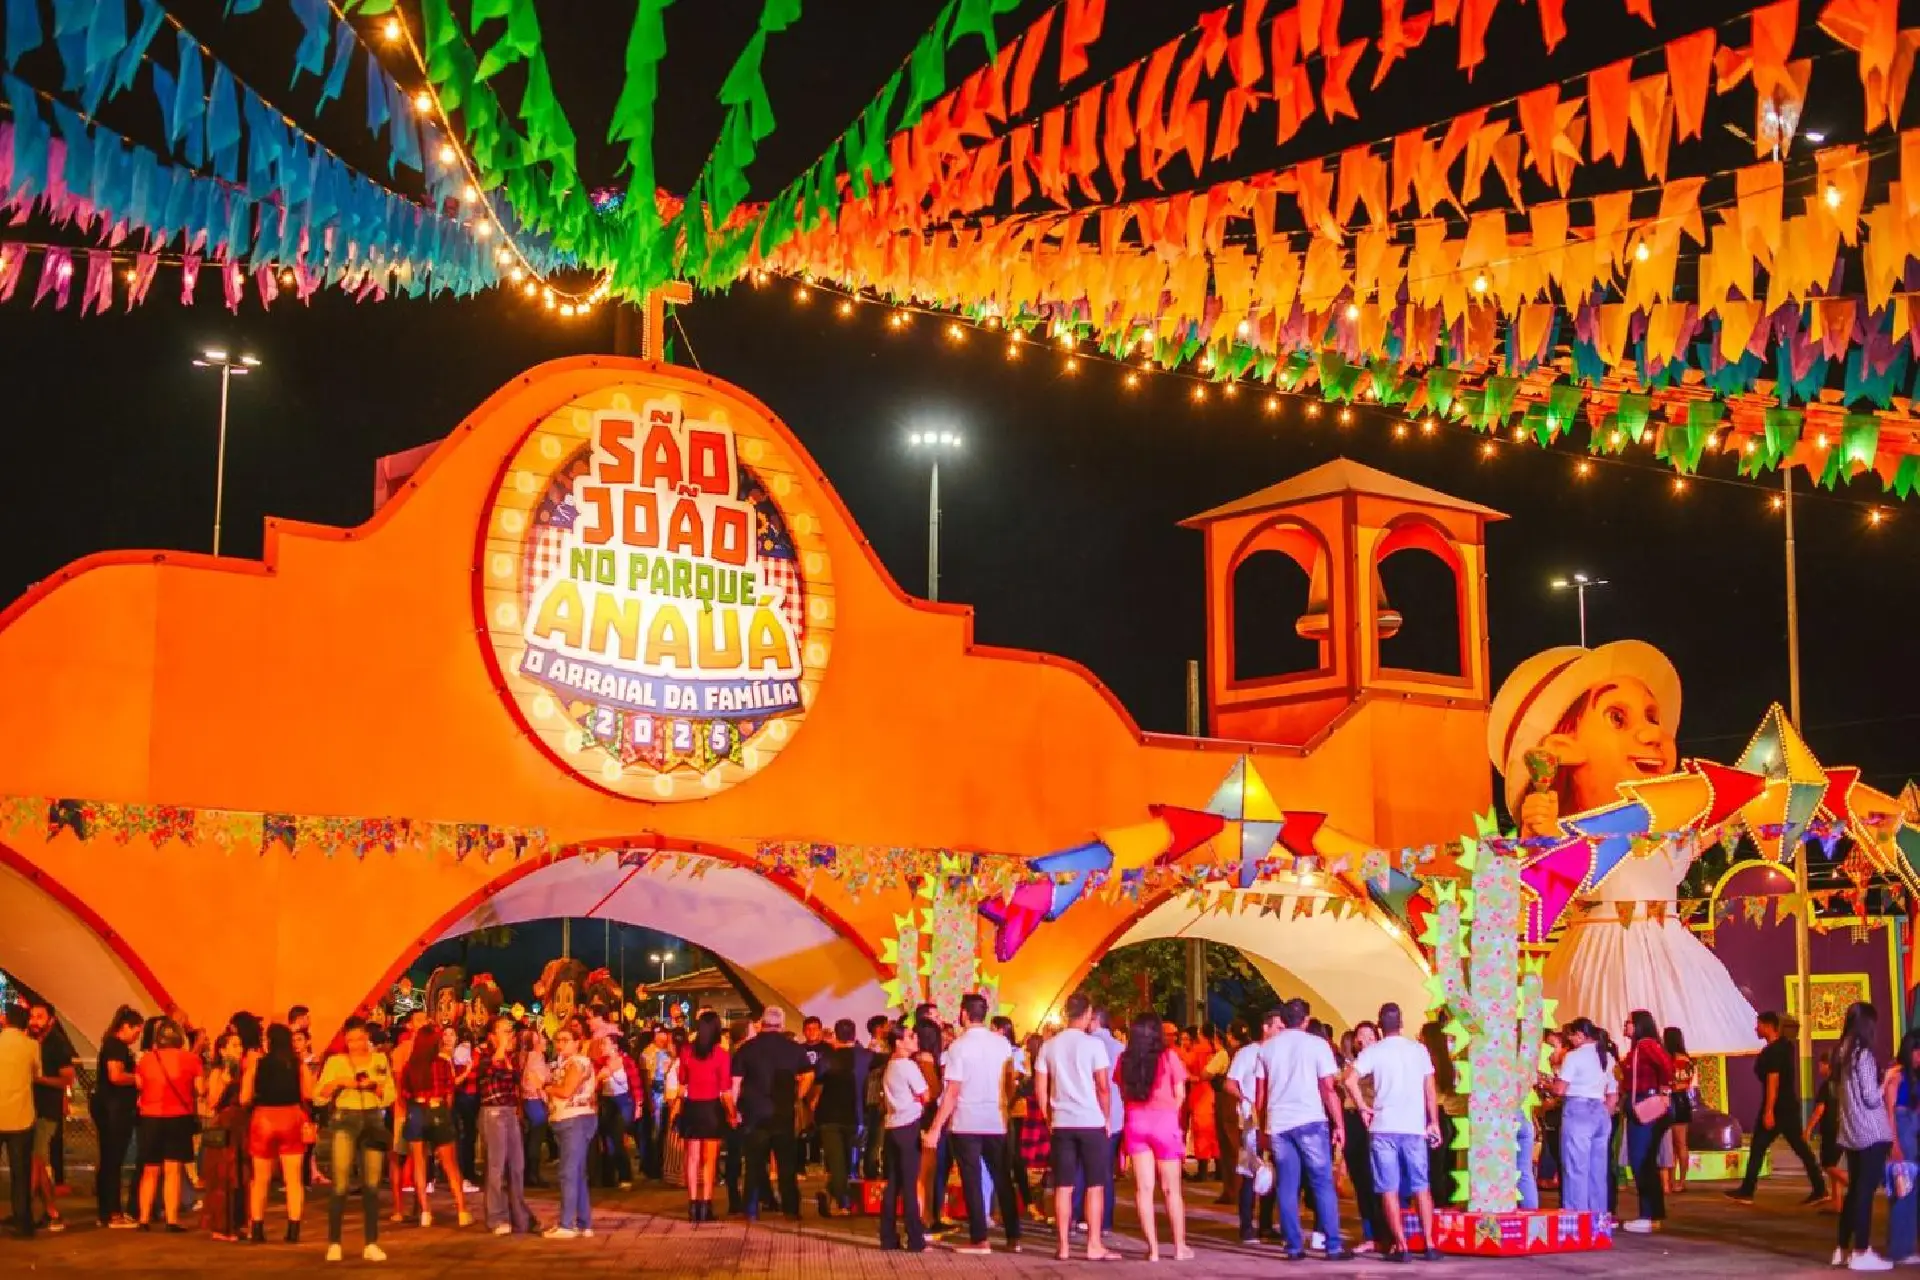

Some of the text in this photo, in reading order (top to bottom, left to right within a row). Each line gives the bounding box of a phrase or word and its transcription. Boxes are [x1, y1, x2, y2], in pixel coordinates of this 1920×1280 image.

[600, 409, 729, 495] SÃO
[582, 484, 749, 566] JOÃO
[569, 547, 757, 614] NO PARQUE
[533, 579, 792, 671] ANAUÁ
[526, 649, 798, 712] O ARRAIAL DA FAMÍLIA
